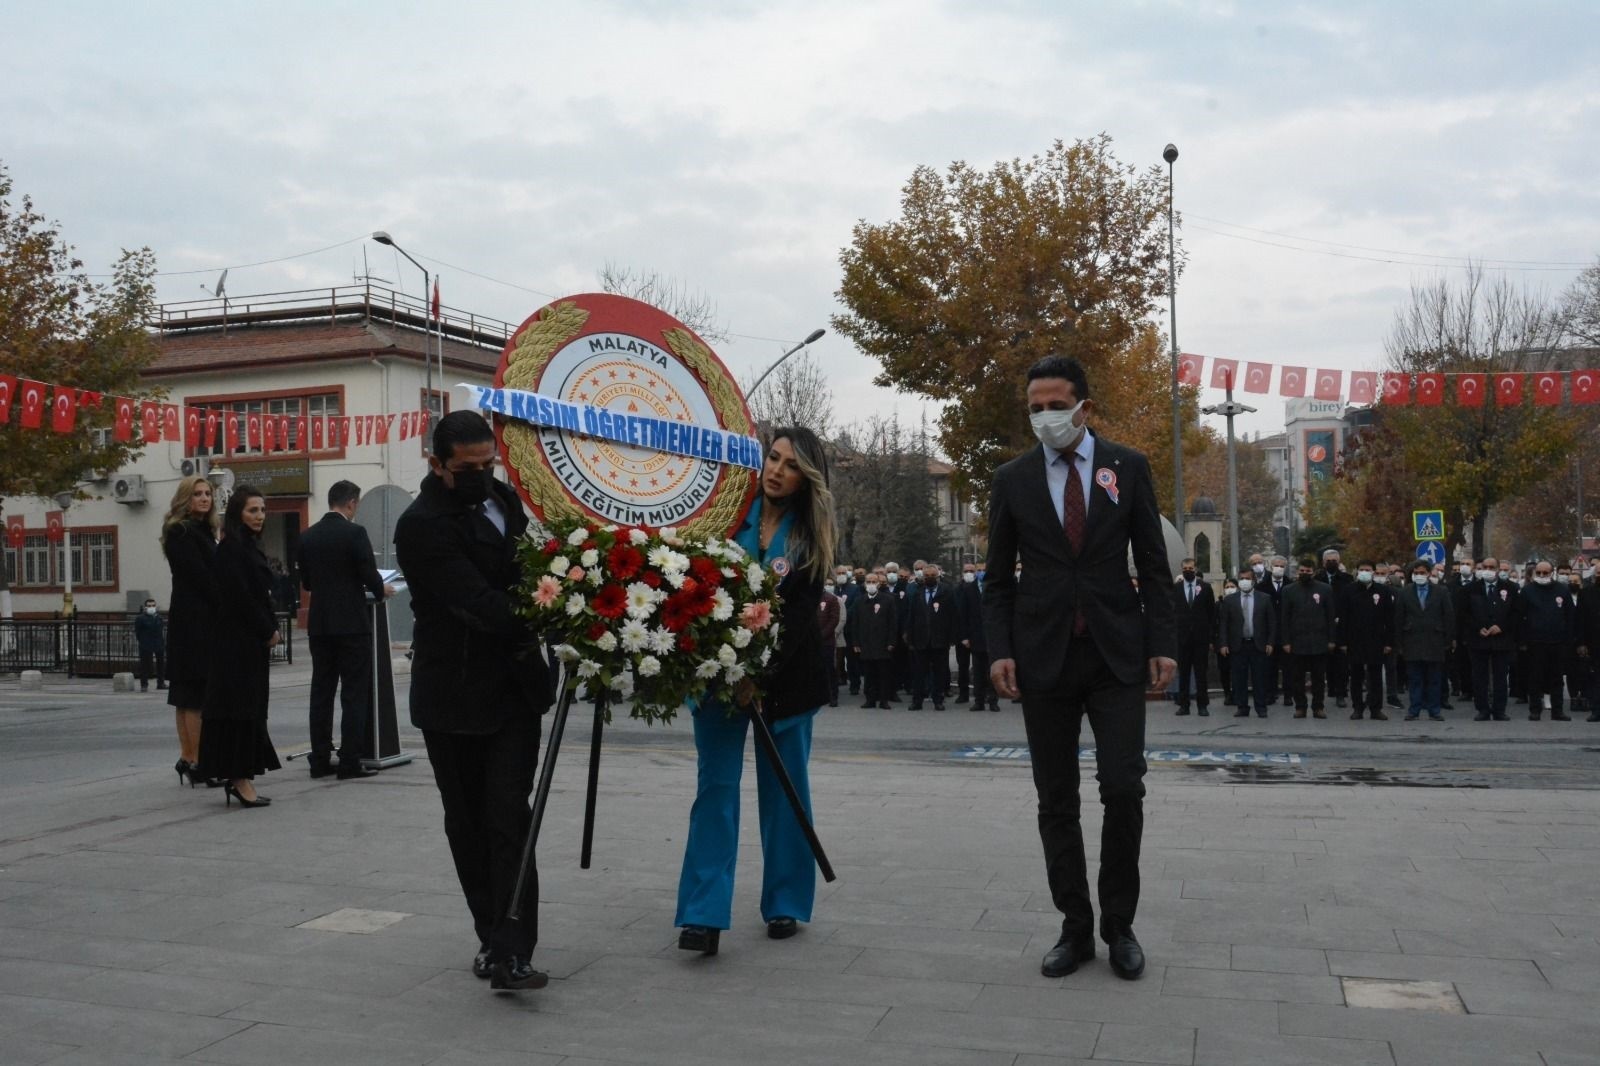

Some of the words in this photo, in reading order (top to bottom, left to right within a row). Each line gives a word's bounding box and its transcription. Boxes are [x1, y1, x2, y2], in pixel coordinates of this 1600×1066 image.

[588, 336, 668, 369] MALATYA
[477, 386, 506, 413] 24
[511, 391, 580, 433] KASIM
[584, 405, 722, 461] ÖĞRETMENLER
[1309, 401, 1344, 414] birey
[544, 440, 585, 492] MİLLİ
[580, 488, 646, 524] EĞİTİM
